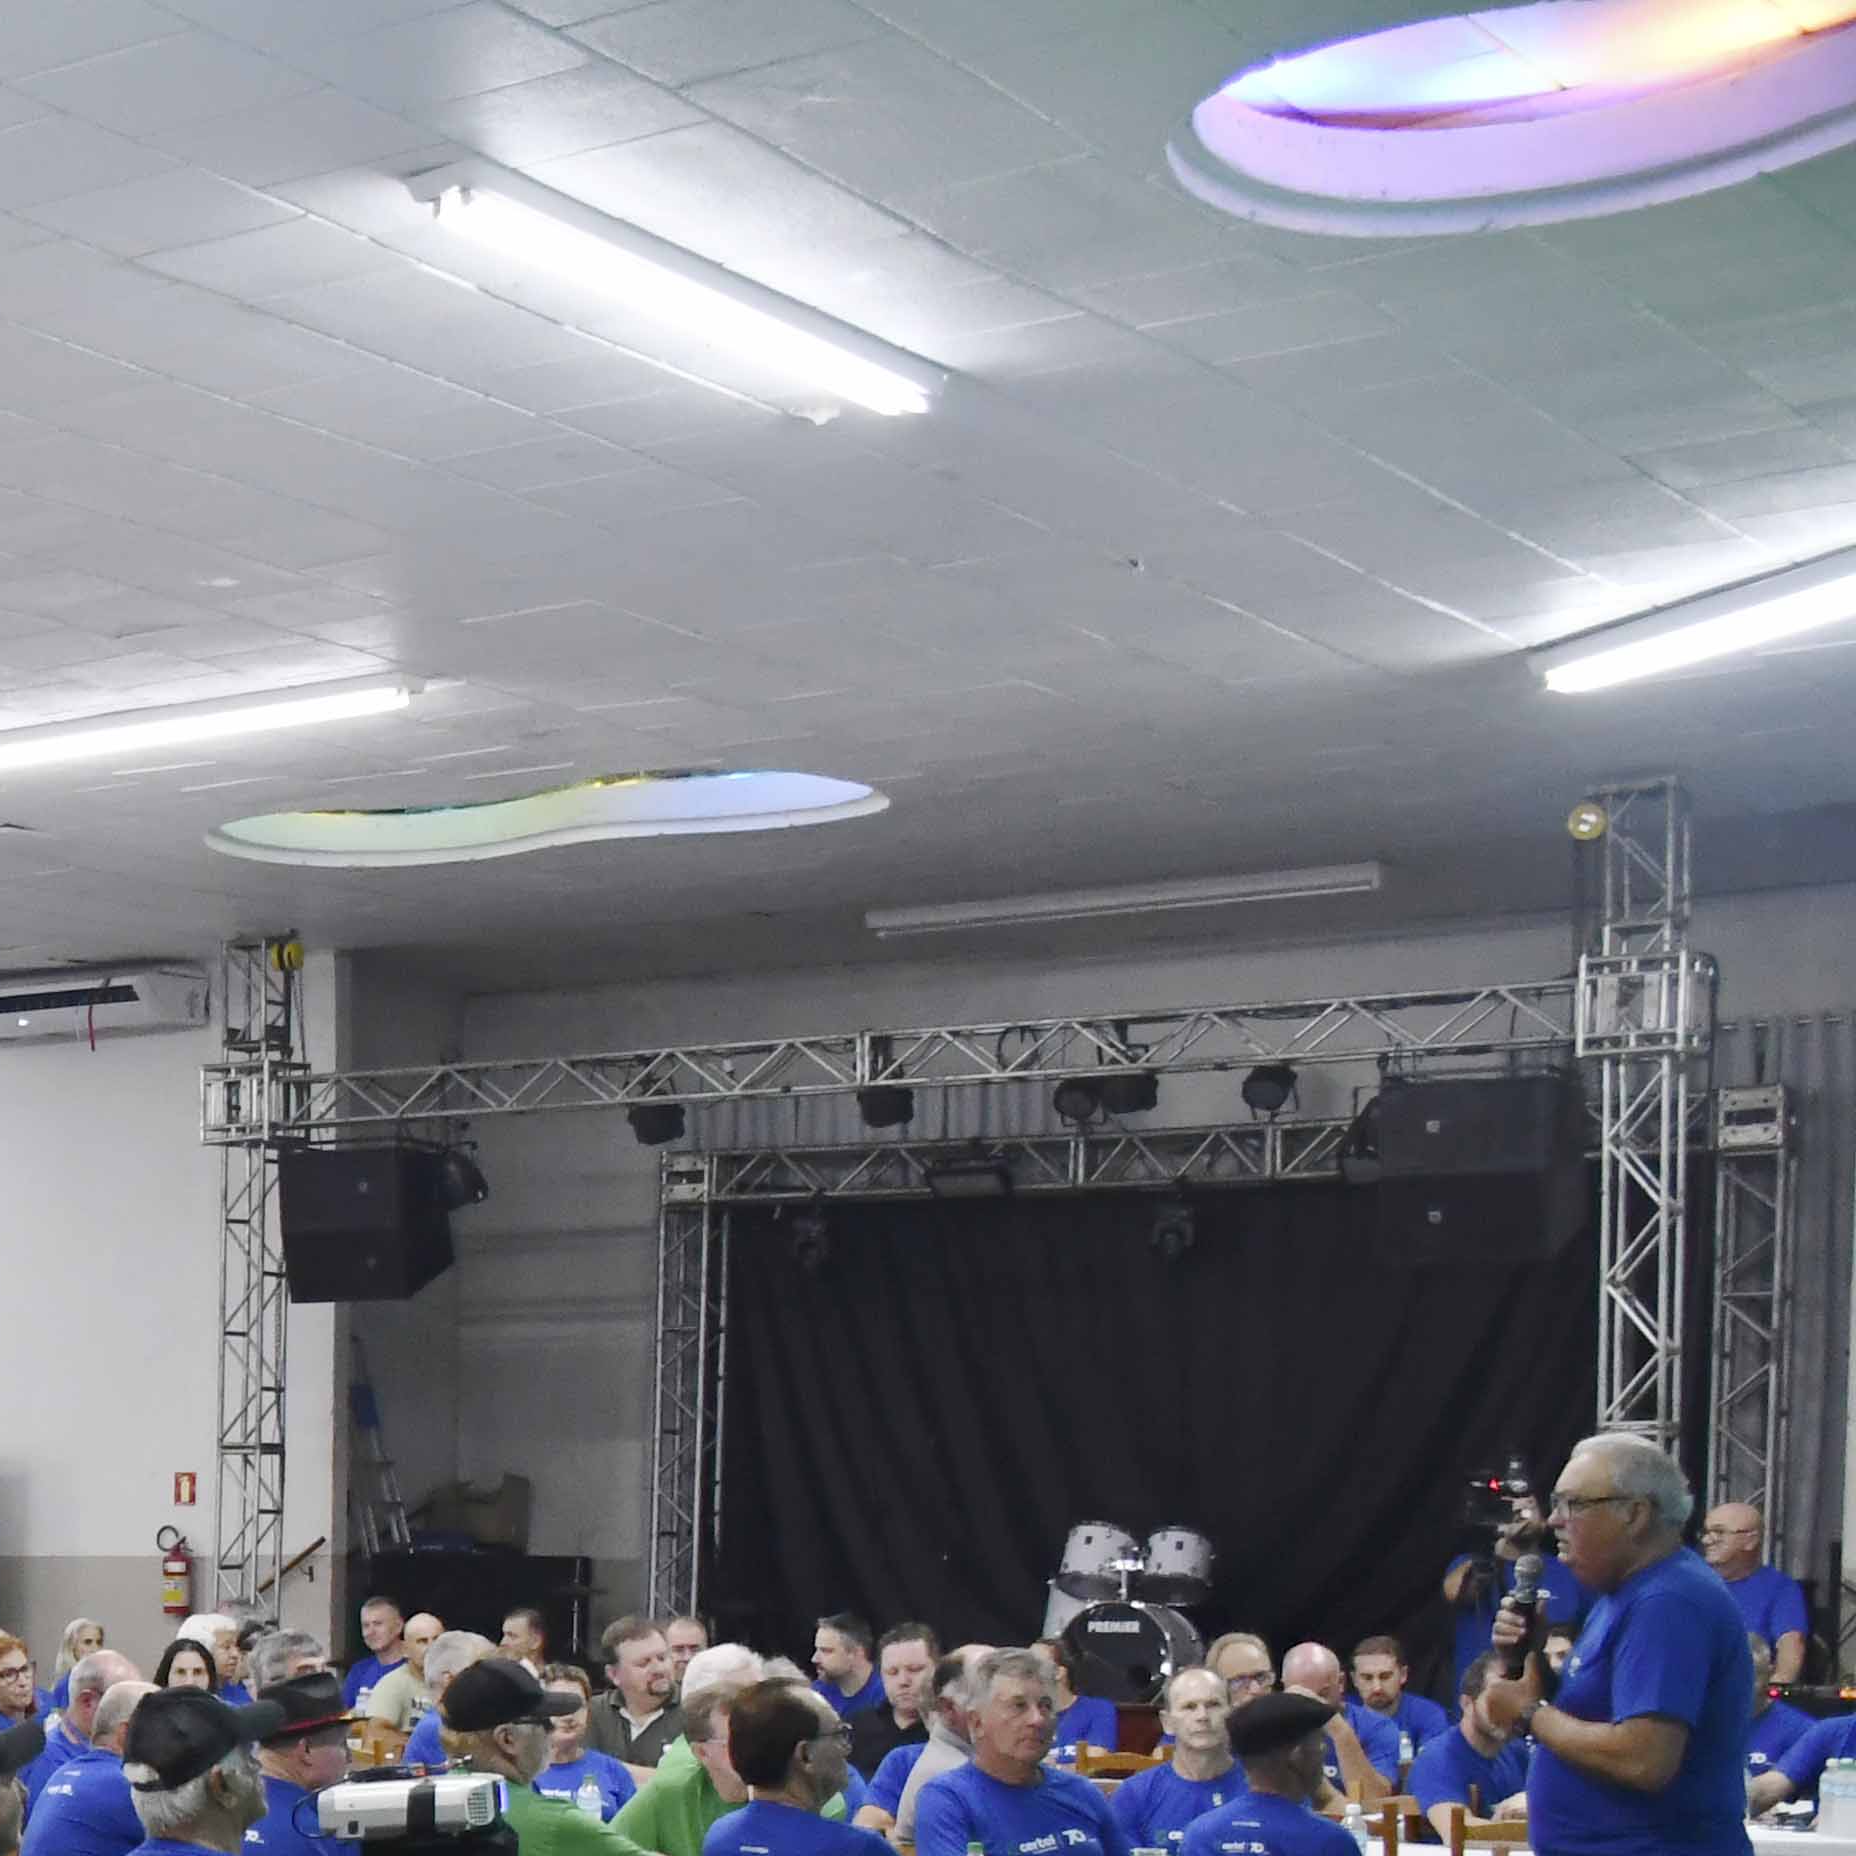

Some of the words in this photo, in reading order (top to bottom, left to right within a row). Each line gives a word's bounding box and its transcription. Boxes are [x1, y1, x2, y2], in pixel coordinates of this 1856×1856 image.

[1087, 1621, 1140, 1633] PREMIER
[1019, 1834, 1056, 1854] certel
[1062, 1829, 1086, 1845] 70
